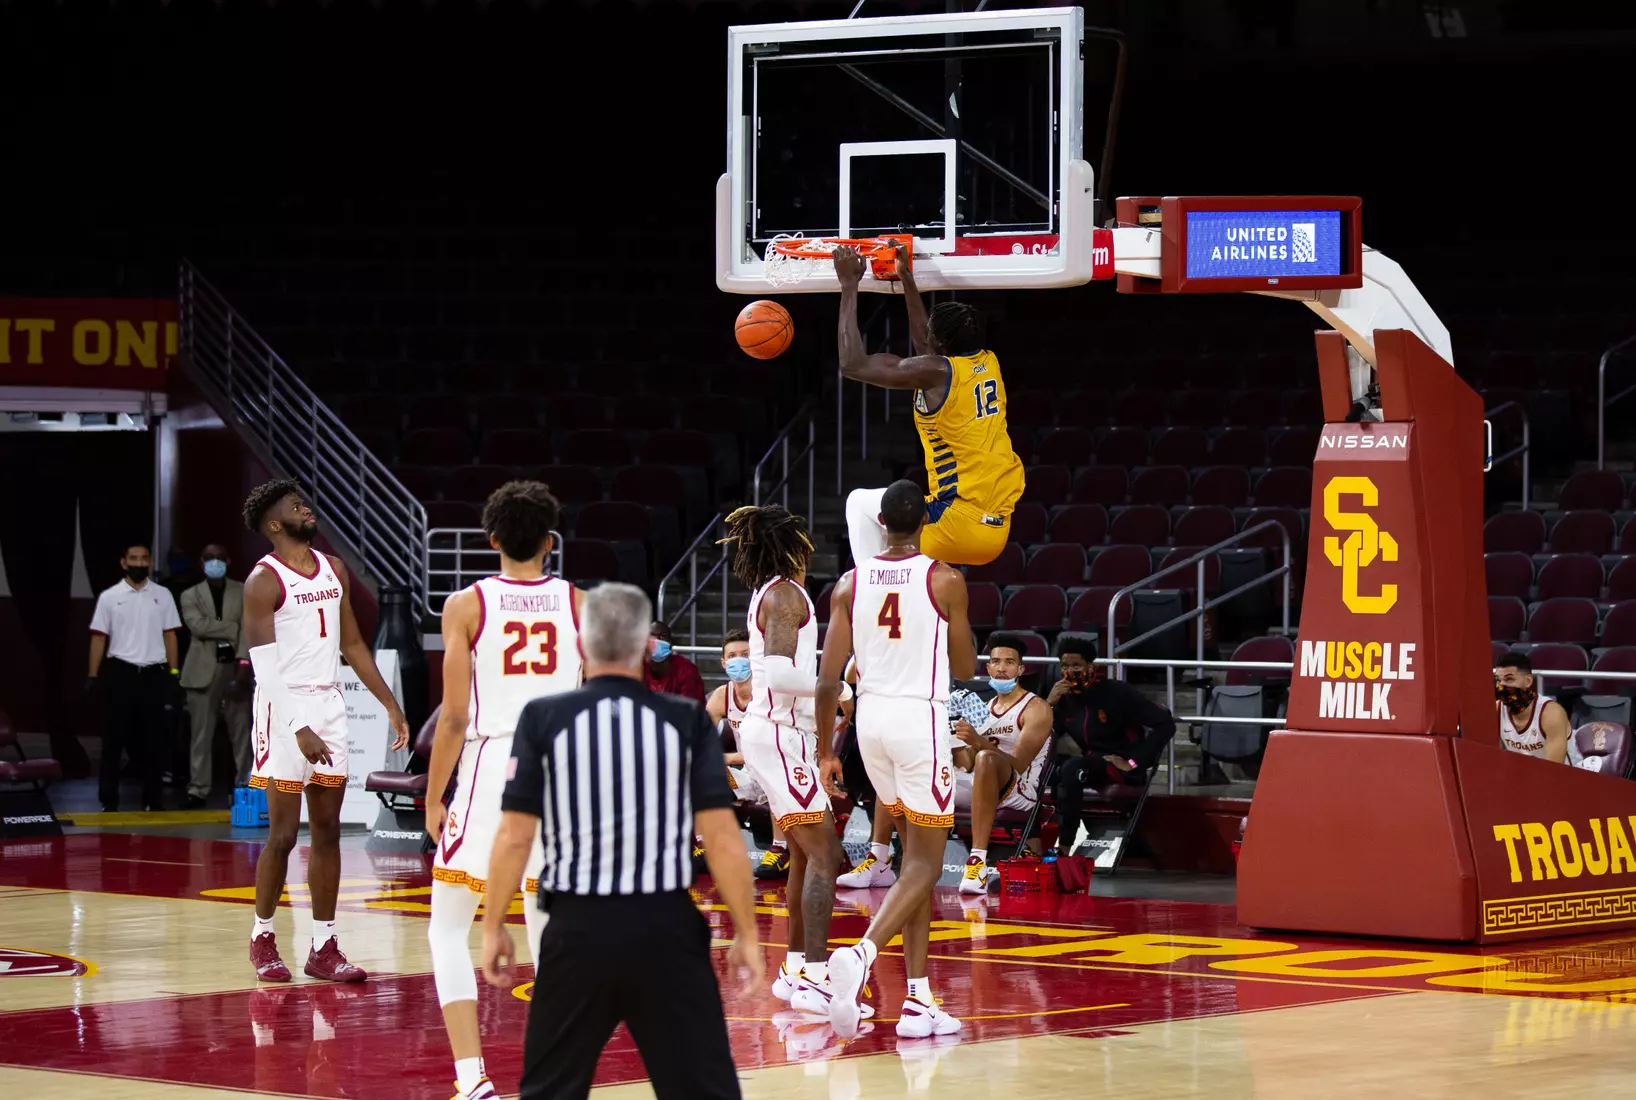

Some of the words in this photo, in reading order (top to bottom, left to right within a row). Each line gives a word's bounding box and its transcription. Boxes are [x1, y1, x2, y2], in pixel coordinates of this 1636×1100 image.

[1227, 227, 1288, 242] UNITED
[1211, 245, 1288, 261] AIRLINES
[973, 378, 1000, 420] 12
[1320, 434, 1408, 449] NISSAN
[294, 588, 340, 605] TROJANS
[317, 607, 328, 639] 1
[877, 592, 902, 640] 4
[503, 620, 558, 676] 23
[1300, 640, 1416, 681] MUSCLE
[1504, 740, 1544, 753] TROJANS
[3, 815, 54, 825] POWERADE
[373, 830, 423, 840] POWERADE
